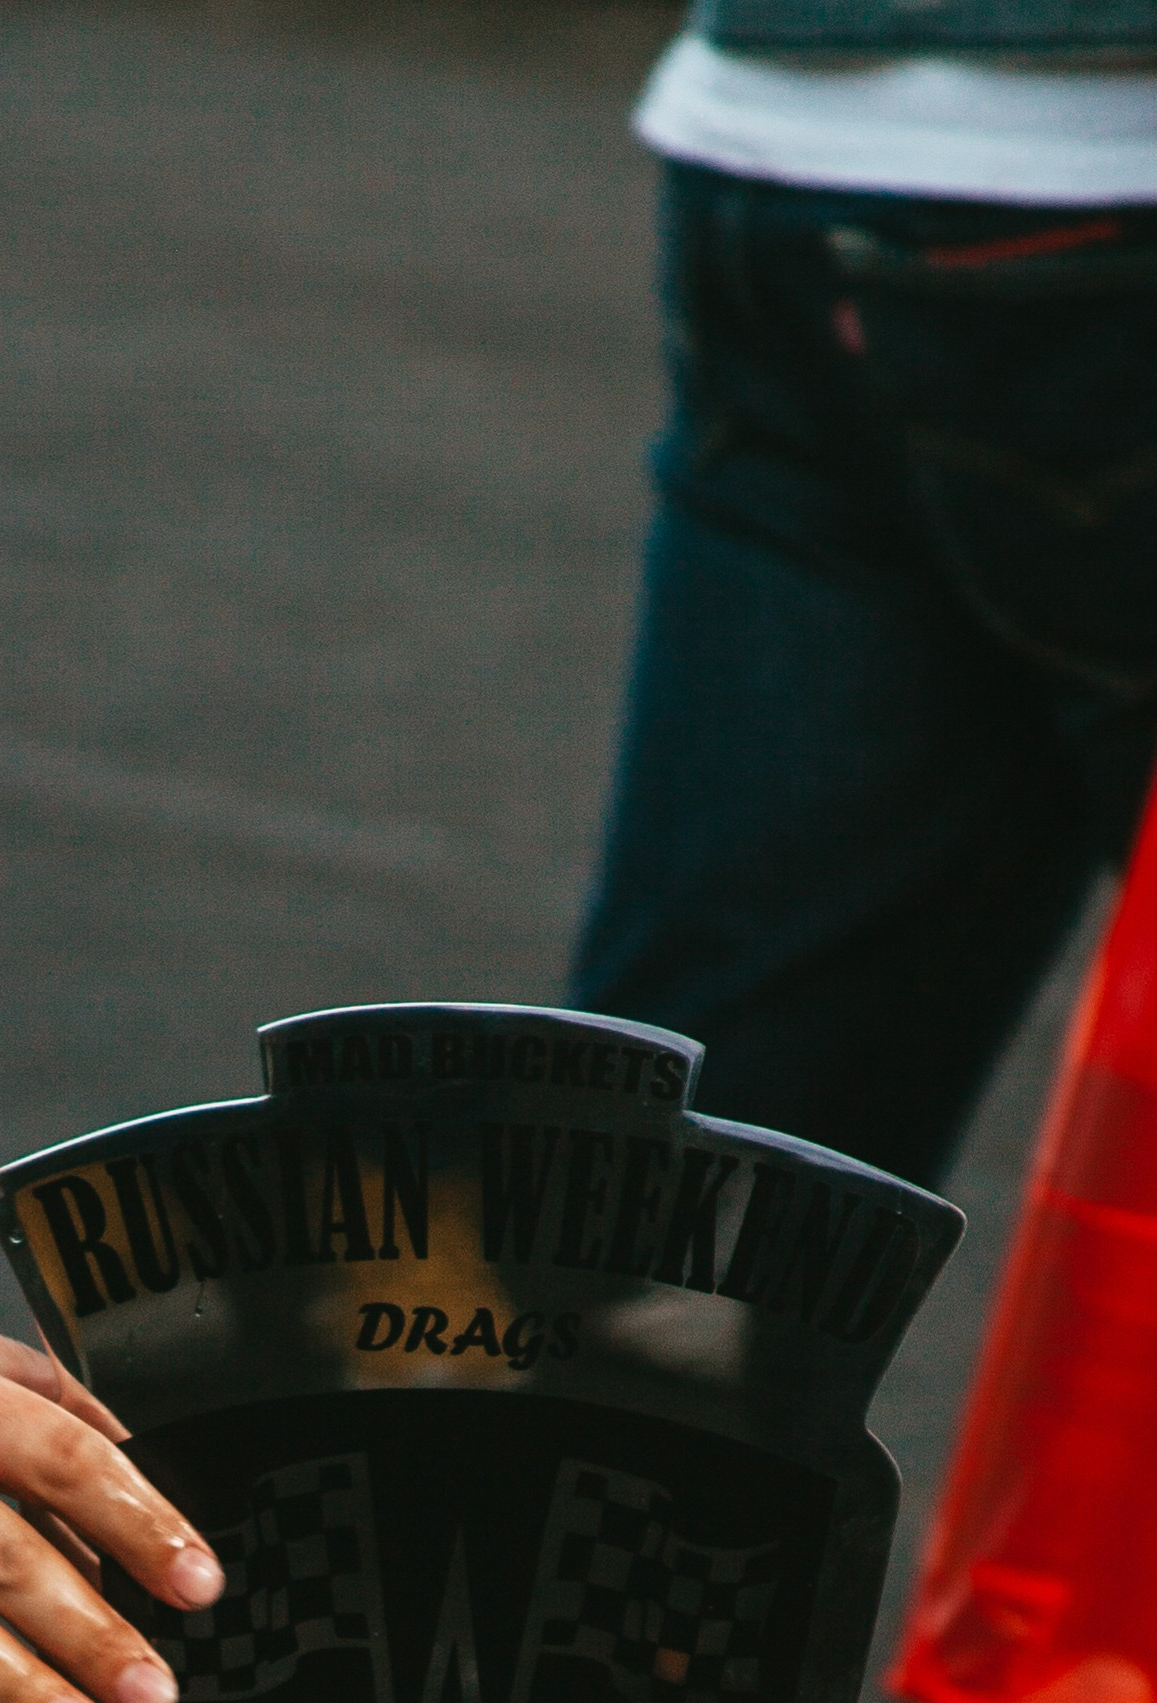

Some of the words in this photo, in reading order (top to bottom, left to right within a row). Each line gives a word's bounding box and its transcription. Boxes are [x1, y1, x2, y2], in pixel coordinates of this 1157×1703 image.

[285, 1034, 413, 1088] MAD
[432, 1034, 687, 1102] BUCKETS
[33, 1122, 432, 1317] RUSSIAN
[477, 1122, 921, 1344] WEEKEND
[355, 1302, 582, 1371] DRAGS
